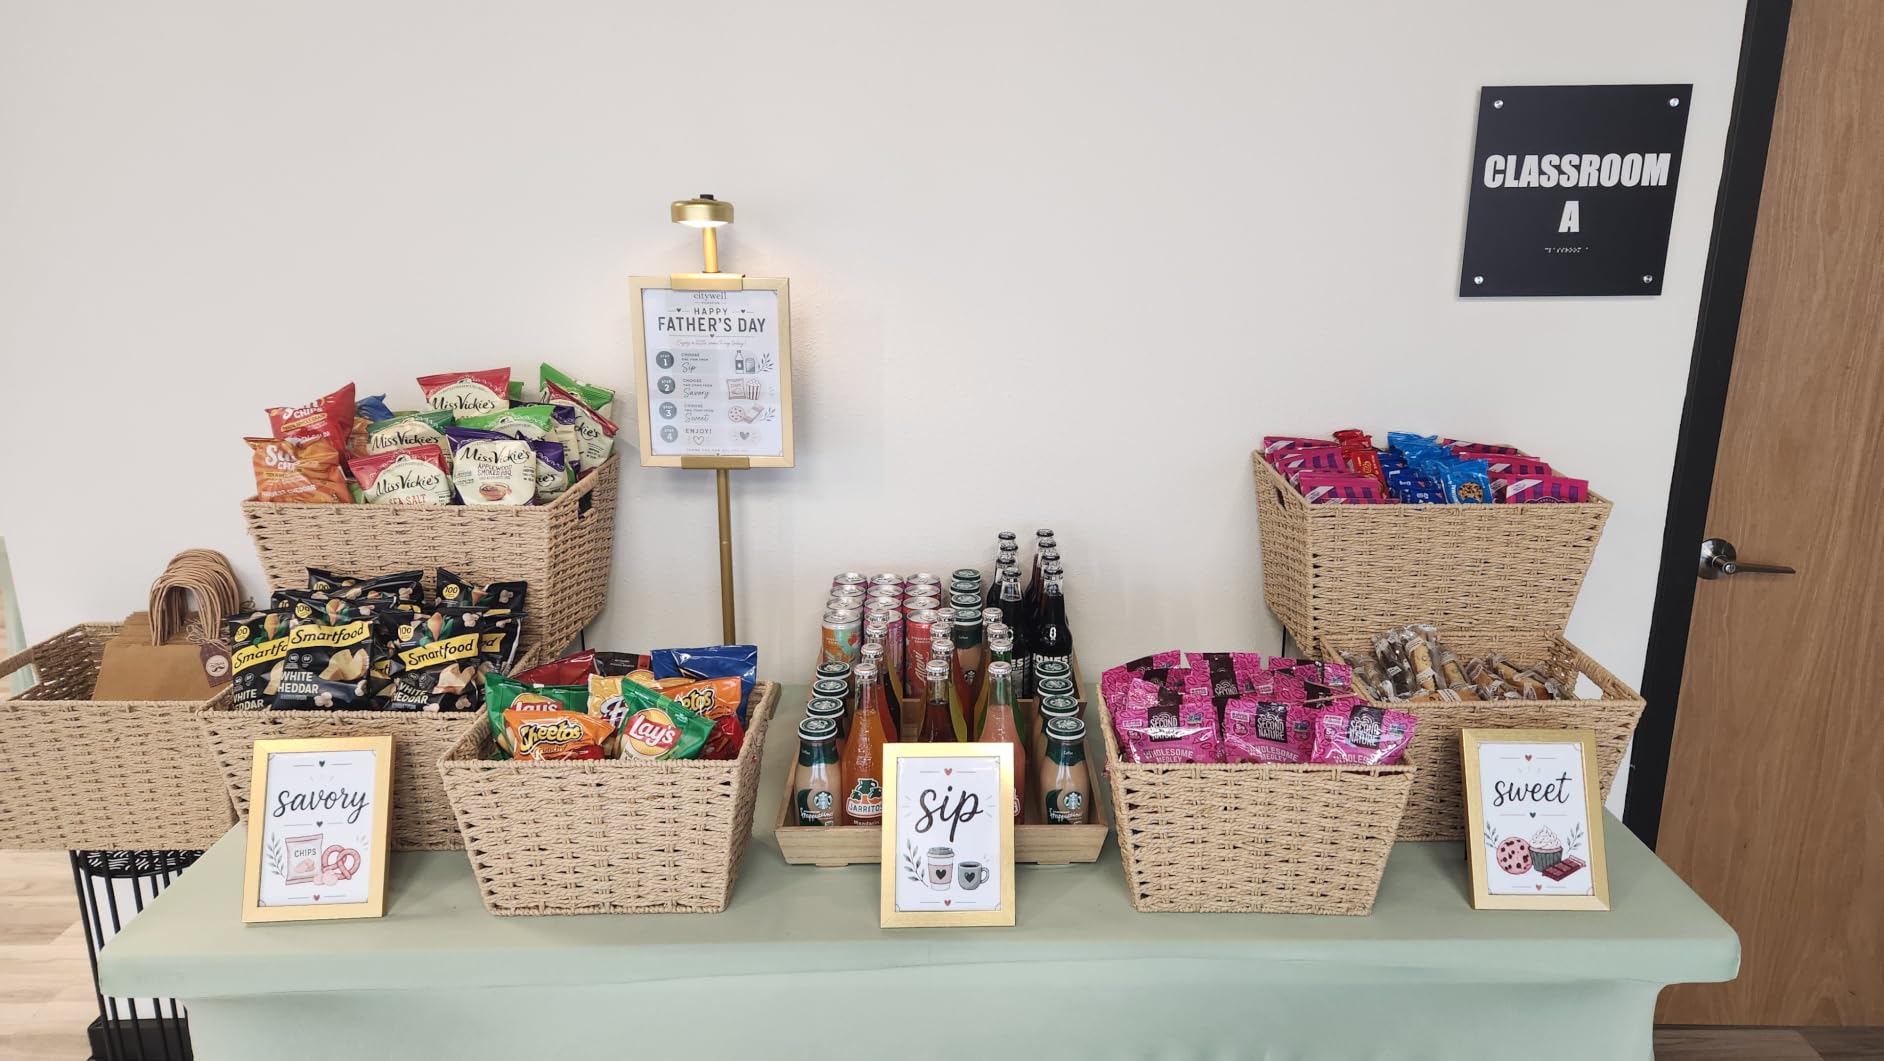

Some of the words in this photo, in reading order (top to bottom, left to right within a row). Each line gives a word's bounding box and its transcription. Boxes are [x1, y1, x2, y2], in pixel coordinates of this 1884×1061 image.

[1484, 153, 1671, 188] CLASSROOM
[1558, 200, 1580, 233] A
[693, 291, 727, 301] citywell
[694, 307, 728, 316] HAPPY
[658, 316, 732, 332] FATHER'S
[738, 318, 766, 333] DAY
[663, 358, 668, 367] 1
[681, 361, 697, 374] Sip
[664, 383, 670, 392] 2
[683, 387, 709, 400] Savory
[432, 396, 458, 411] Miss
[456, 392, 496, 413] Vickie's
[665, 409, 672, 417] 3
[574, 421, 600, 441] ckie's
[372, 433, 399, 451] Miss
[397, 429, 439, 445] Vickie's
[460, 447, 492, 463] Miss
[492, 446, 530, 465] Vickie's
[376, 479, 400, 497] Miss
[398, 470, 440, 491] Vickie's
[405, 494, 426, 505] SALT
[445, 586, 458, 594] 100
[291, 625, 364, 645] Smartfood
[234, 639, 288, 669] Smartfo
[408, 638, 474, 666] Smartfood
[281, 671, 313, 682] WHITE
[278, 682, 319, 694] HEDDAR
[1214, 686, 1238, 696] SECOND
[394, 692, 429, 705] HEDDAR
[682, 687, 715, 712] etos
[1150, 716, 1178, 728] SECOND
[1257, 717, 1284, 732] SECOND
[1350, 718, 1379, 735] SECOND
[520, 719, 582, 753] Cheetos
[629, 715, 677, 747] Lay's
[1258, 727, 1285, 741] NATURE
[1349, 728, 1378, 746] NATURE
[1144, 748, 1194, 760] WHOLESOME
[1156, 755, 1182, 763] MEDLEY
[1261, 753, 1287, 761] MEDLEY
[1493, 771, 1573, 808] sweet
[272, 787, 371, 825] savory
[914, 785, 984, 843] sip
[294, 848, 317, 858] CHIPS
